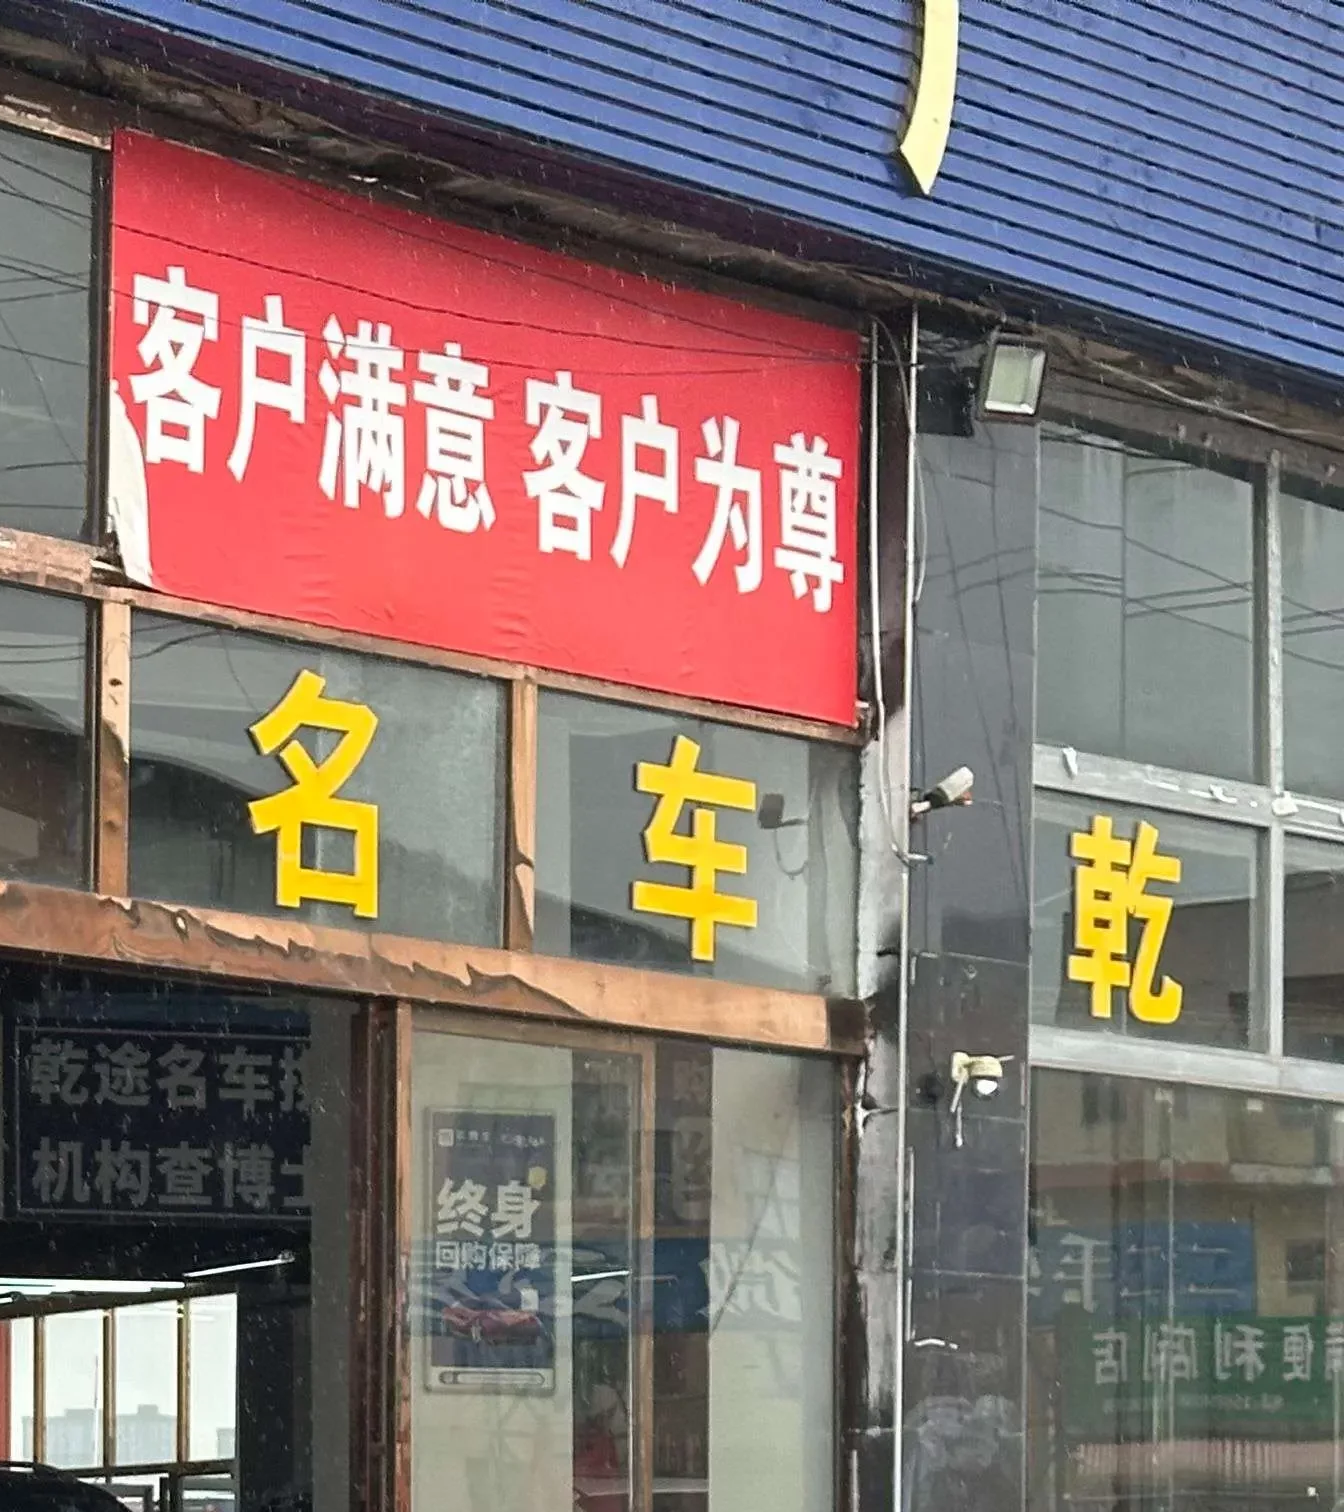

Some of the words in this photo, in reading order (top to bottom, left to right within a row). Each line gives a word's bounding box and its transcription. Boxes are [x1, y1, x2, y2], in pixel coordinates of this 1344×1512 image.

[129, 266, 496, 533] 客户满意
[524, 371, 845, 613] 客户为尊
[1067, 815, 1183, 1024] 乾
[436, 1177, 540, 1239] 终身
